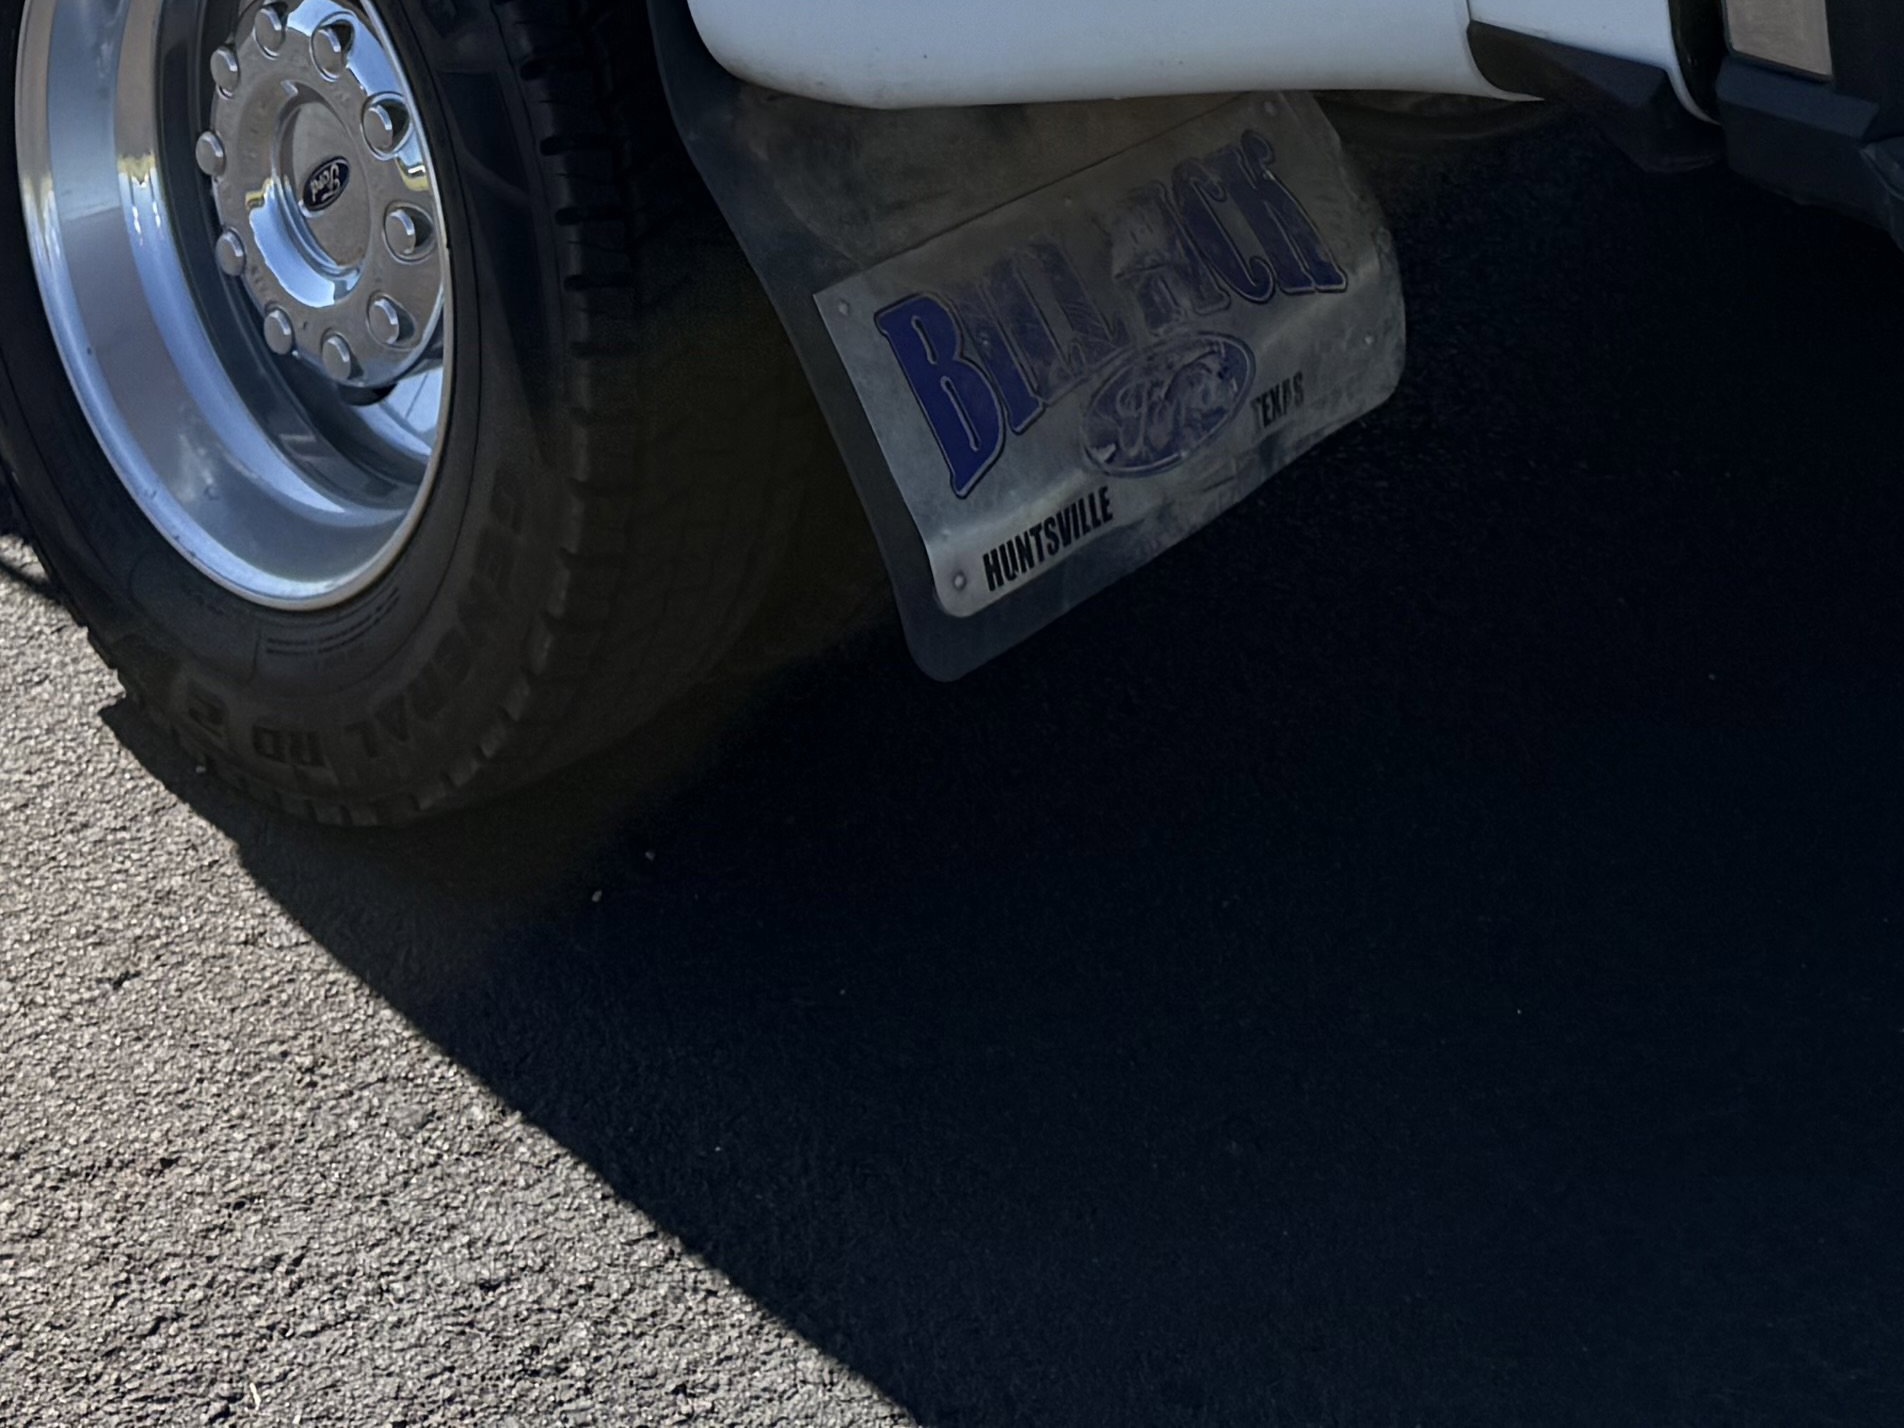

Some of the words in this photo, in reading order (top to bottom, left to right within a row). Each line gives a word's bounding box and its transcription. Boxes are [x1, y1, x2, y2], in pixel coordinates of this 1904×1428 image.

[310, 164, 341, 203] Ford
[1250, 371, 1304, 432] TEXAS
[981, 486, 1114, 592] HUNTSVILLE
